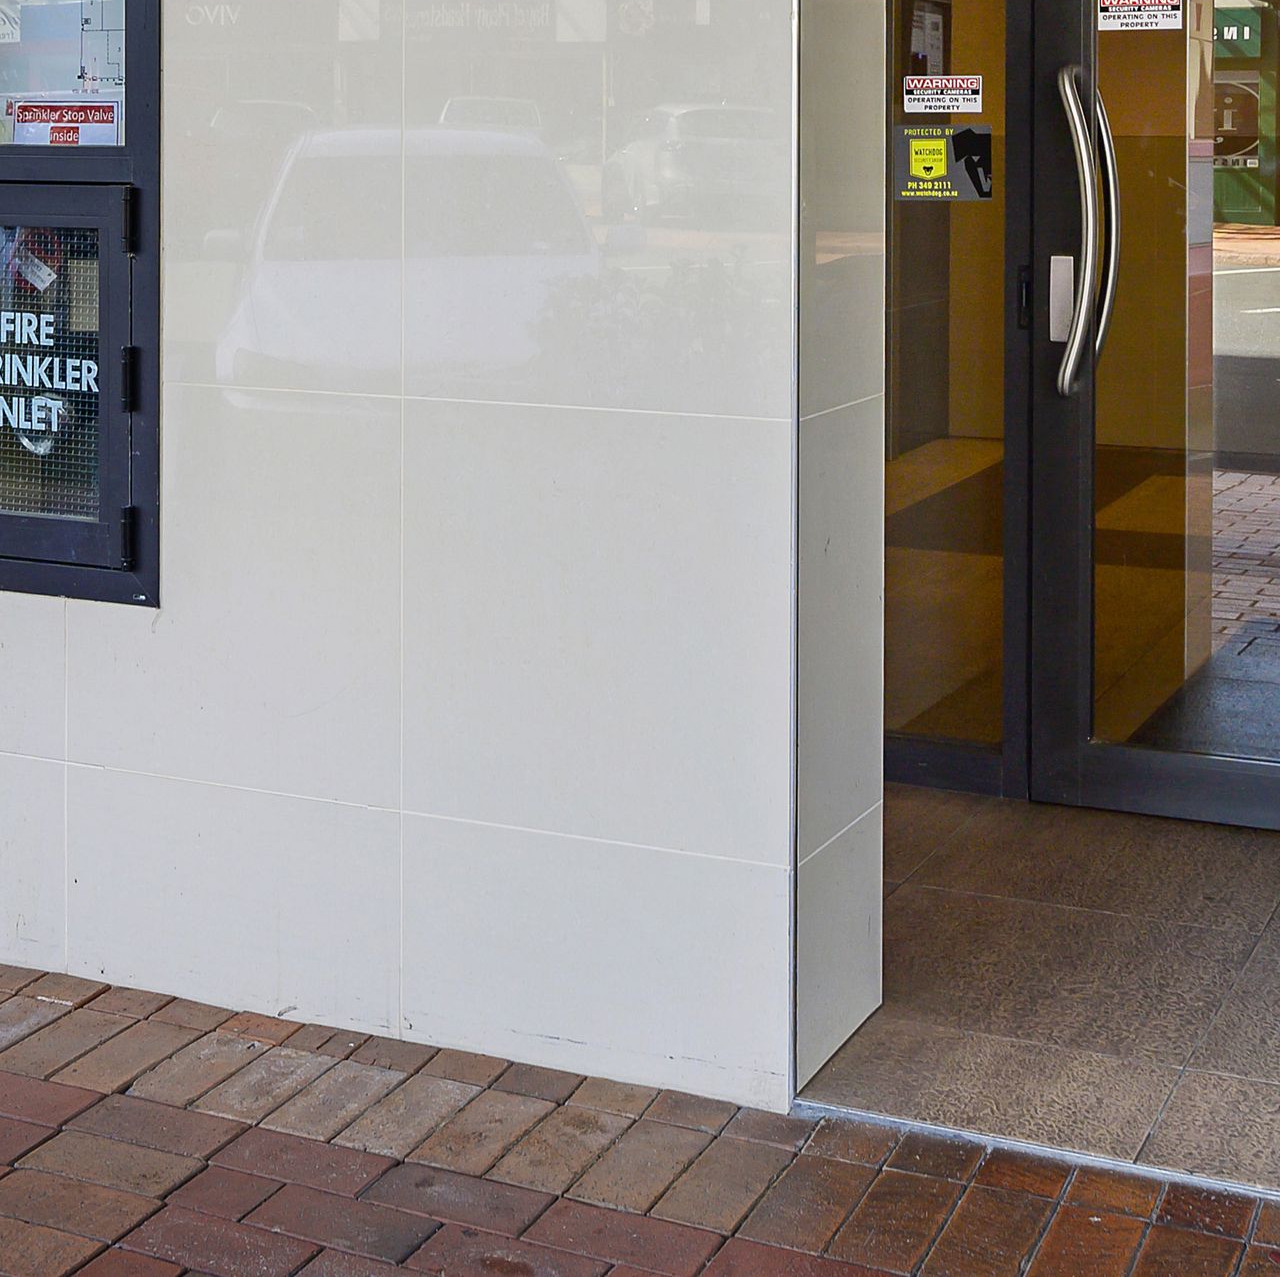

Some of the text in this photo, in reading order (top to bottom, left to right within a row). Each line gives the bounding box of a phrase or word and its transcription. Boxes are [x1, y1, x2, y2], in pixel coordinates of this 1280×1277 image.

[908, 79, 977, 88] WARNING
[17, 109, 114, 123] Sprinkler Stop Valve
[50, 129, 79, 142] inside
[904, 128, 954, 136] PROTECTED BY
[913, 148, 943, 156] WATCHDOG
[907, 181, 951, 189] PH 349 2111
[0, 311, 55, 347] FIRE
